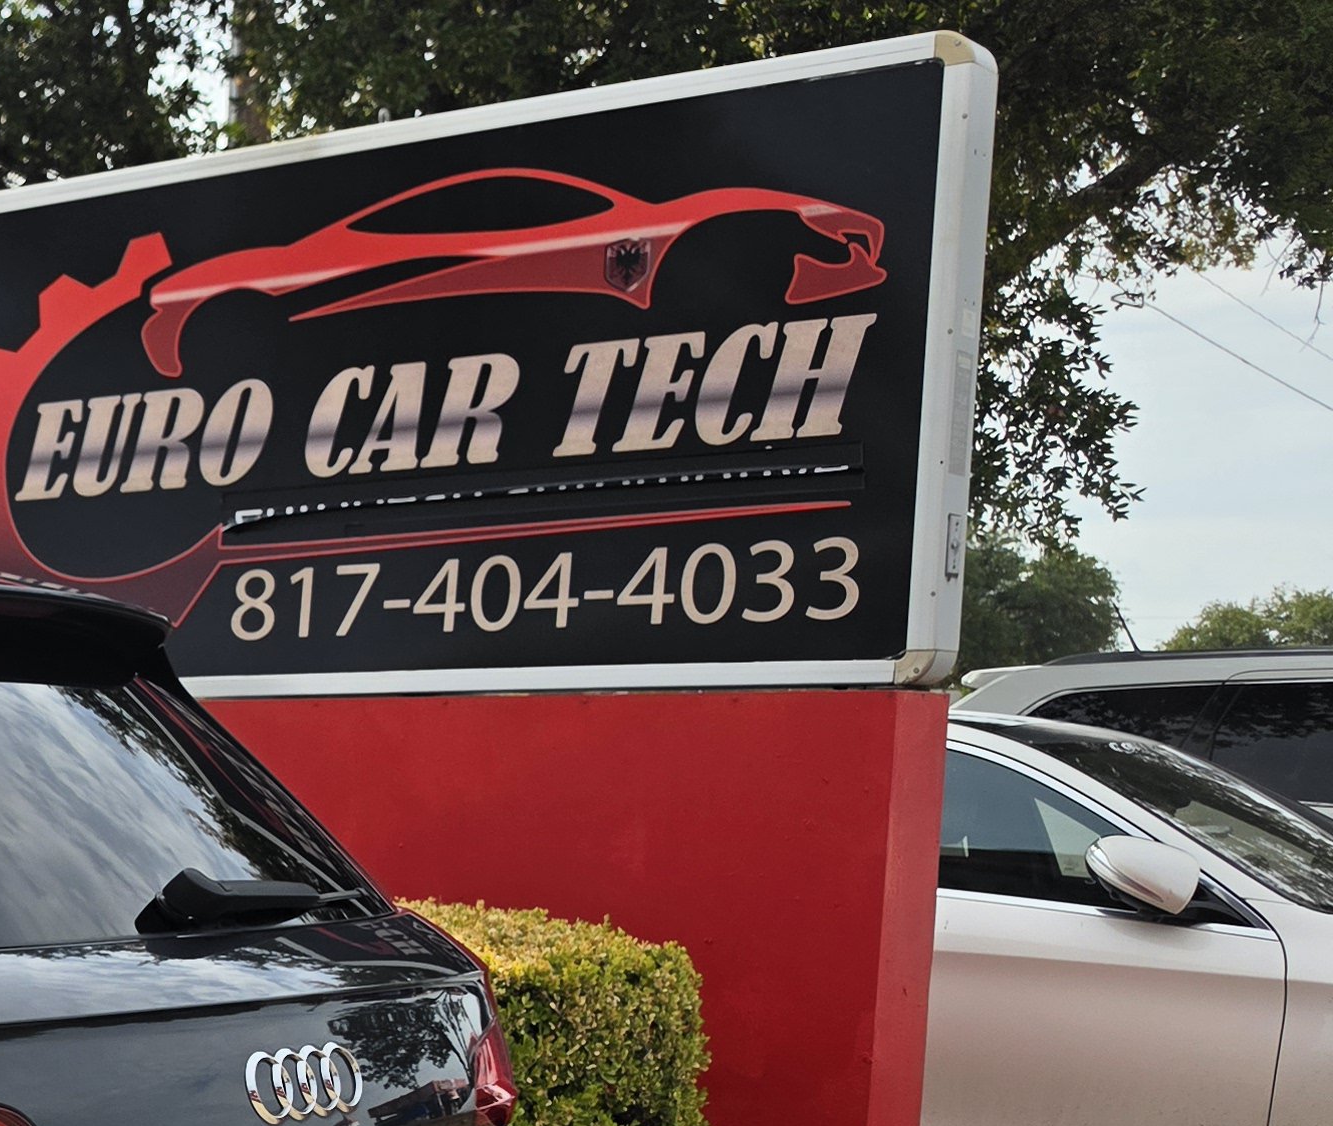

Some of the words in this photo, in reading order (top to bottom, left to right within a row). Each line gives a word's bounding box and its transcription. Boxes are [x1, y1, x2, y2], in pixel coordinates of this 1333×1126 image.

[15, 379, 274, 503] EURO
[303, 352, 521, 478] CAR
[552, 312, 878, 458] TECH
[229, 536, 861, 642] 817-404-4033
